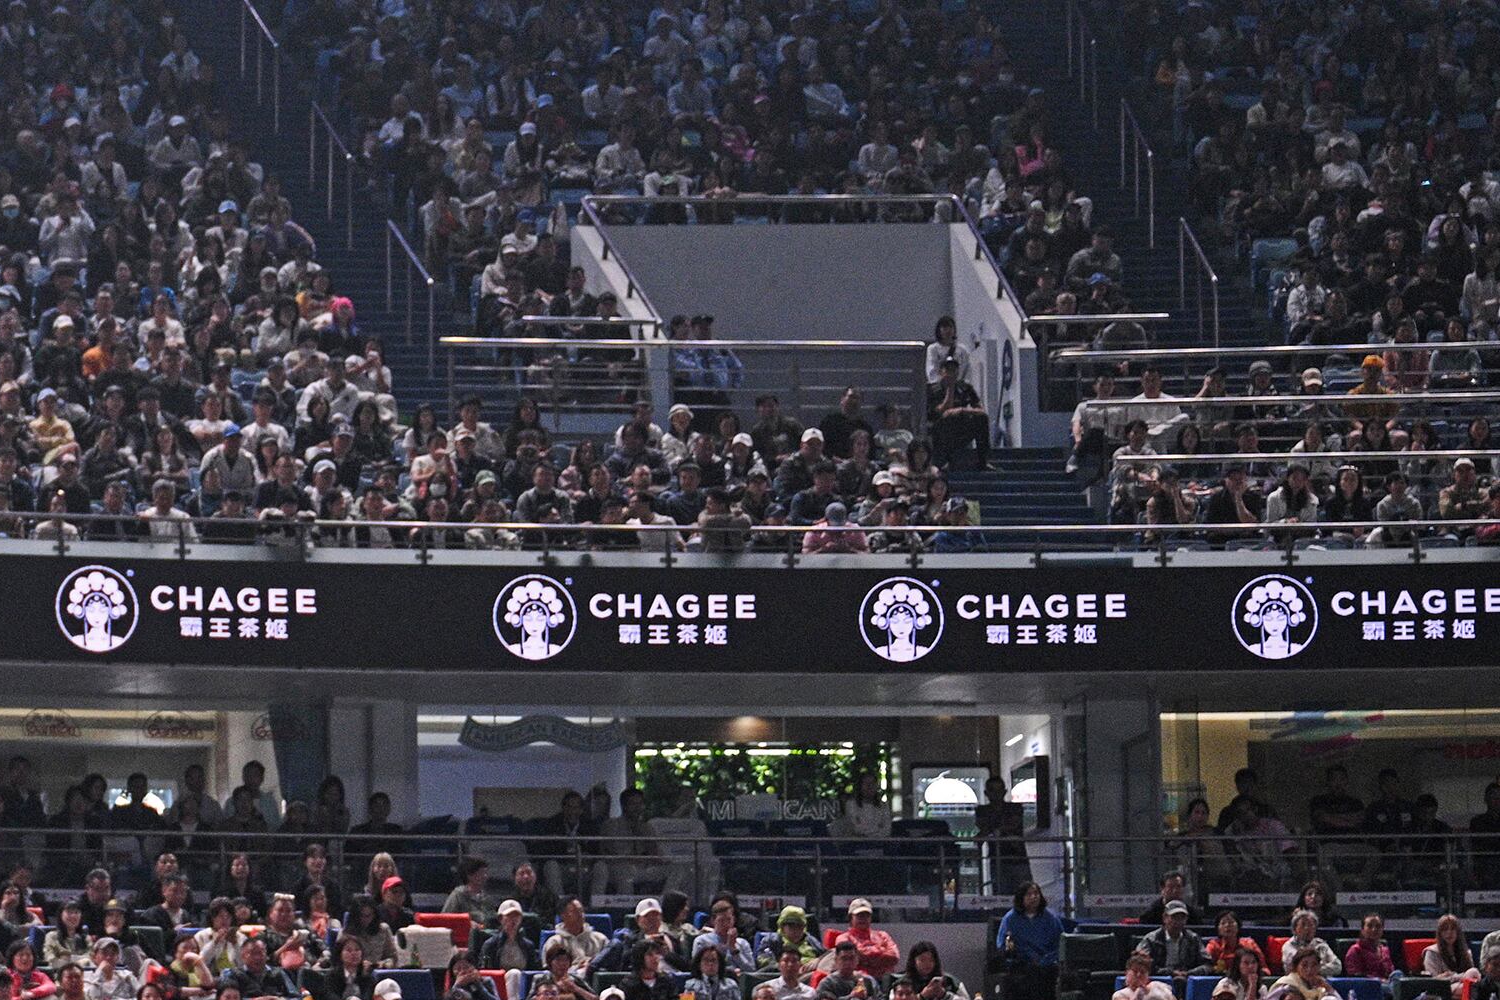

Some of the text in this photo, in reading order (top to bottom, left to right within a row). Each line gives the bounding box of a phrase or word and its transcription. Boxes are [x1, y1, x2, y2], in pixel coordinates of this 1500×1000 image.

[150, 585, 317, 613] CHAGEE
[589, 594, 757, 619] CHAGEE
[956, 594, 1127, 619] CHAGEE
[1331, 589, 1500, 616] CHAGEE
